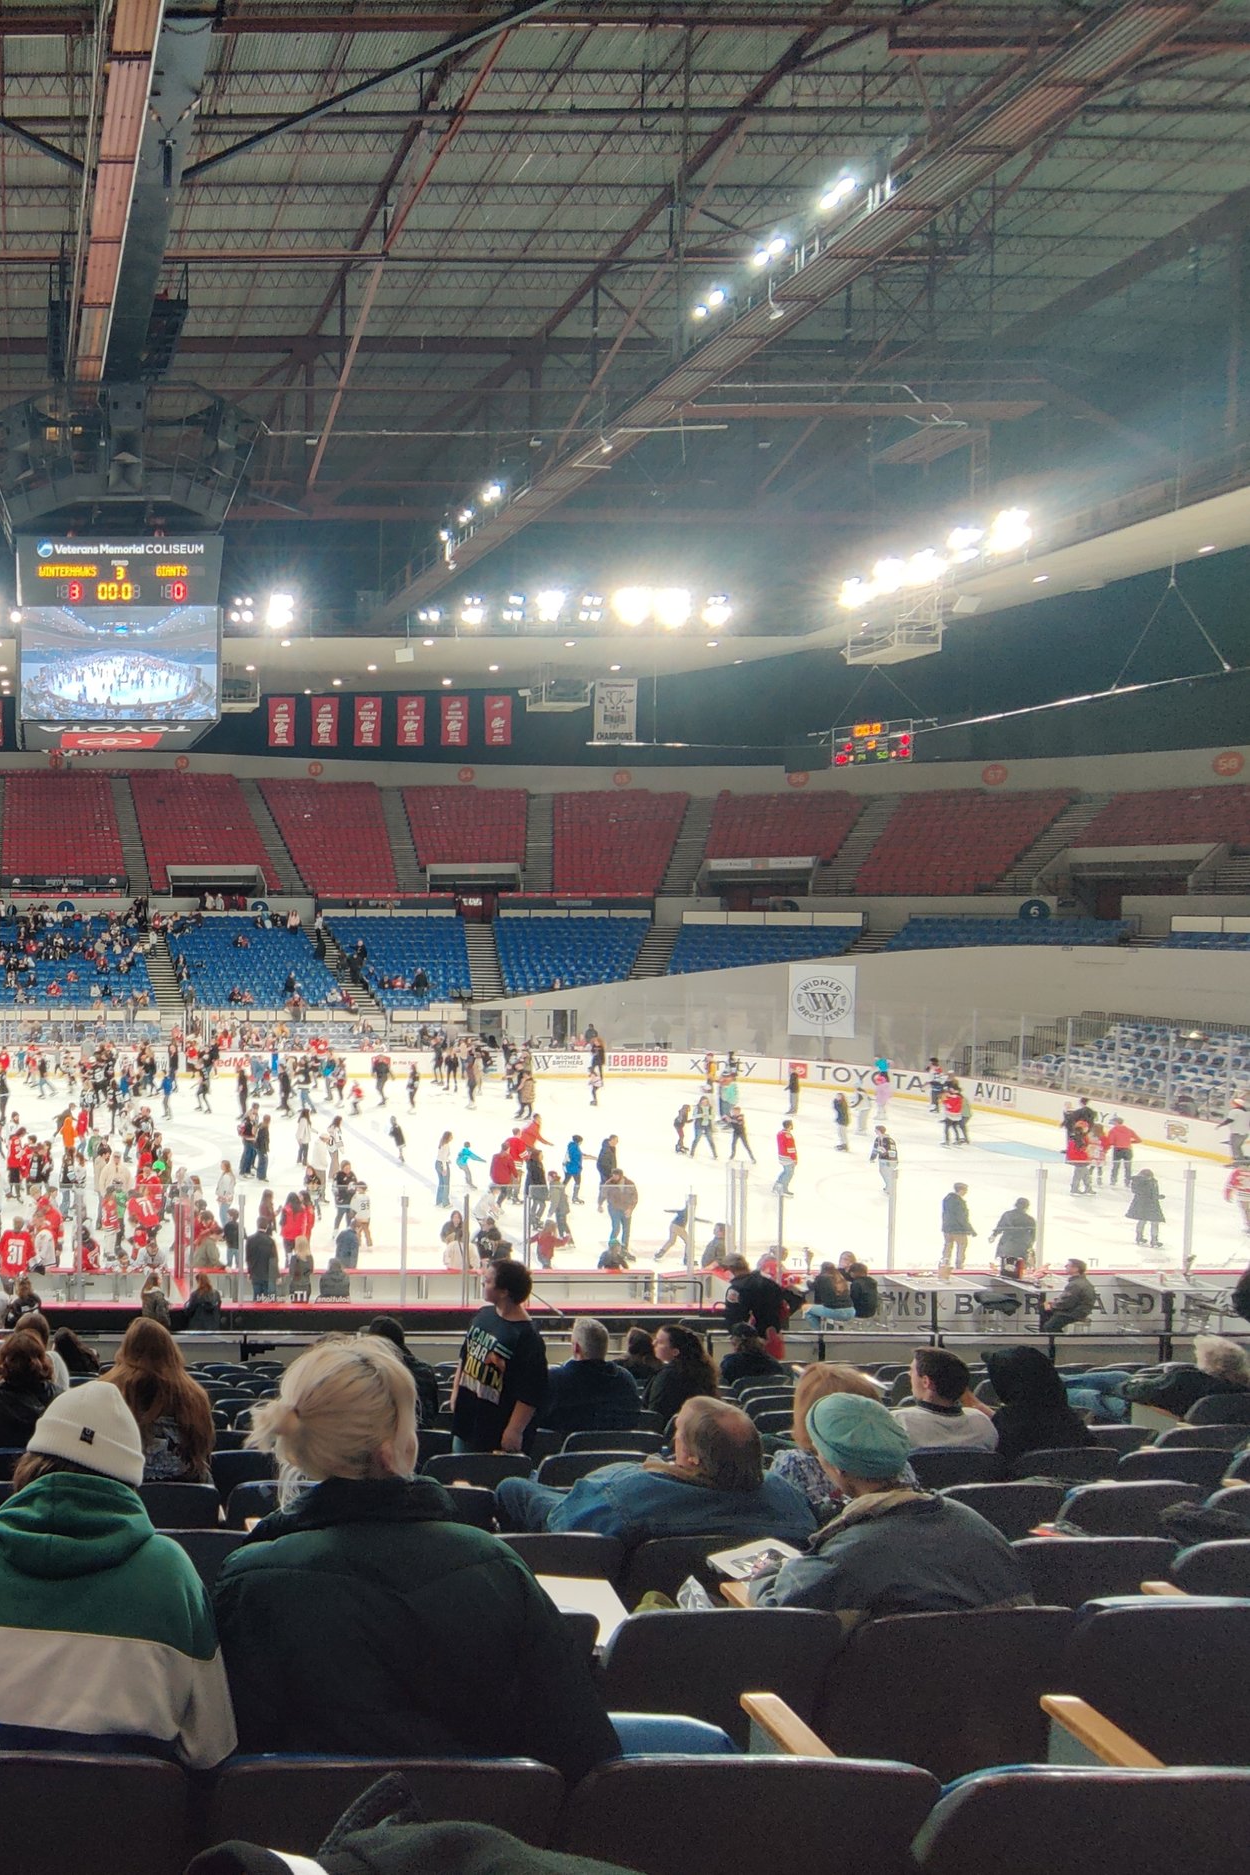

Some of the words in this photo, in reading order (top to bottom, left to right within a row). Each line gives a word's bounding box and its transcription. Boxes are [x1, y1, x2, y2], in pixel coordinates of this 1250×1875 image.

[54, 544, 98, 555] Veterans
[99, 543, 144, 555] Memorial
[145, 544, 204, 554] COLISEUM
[115, 566, 125, 580] 3
[155, 565, 188, 577] GIANTS
[1030, 906, 1039, 917] 6
[800, 980, 843, 993] WIDMER
[975, 1082, 1012, 1102] AVID
